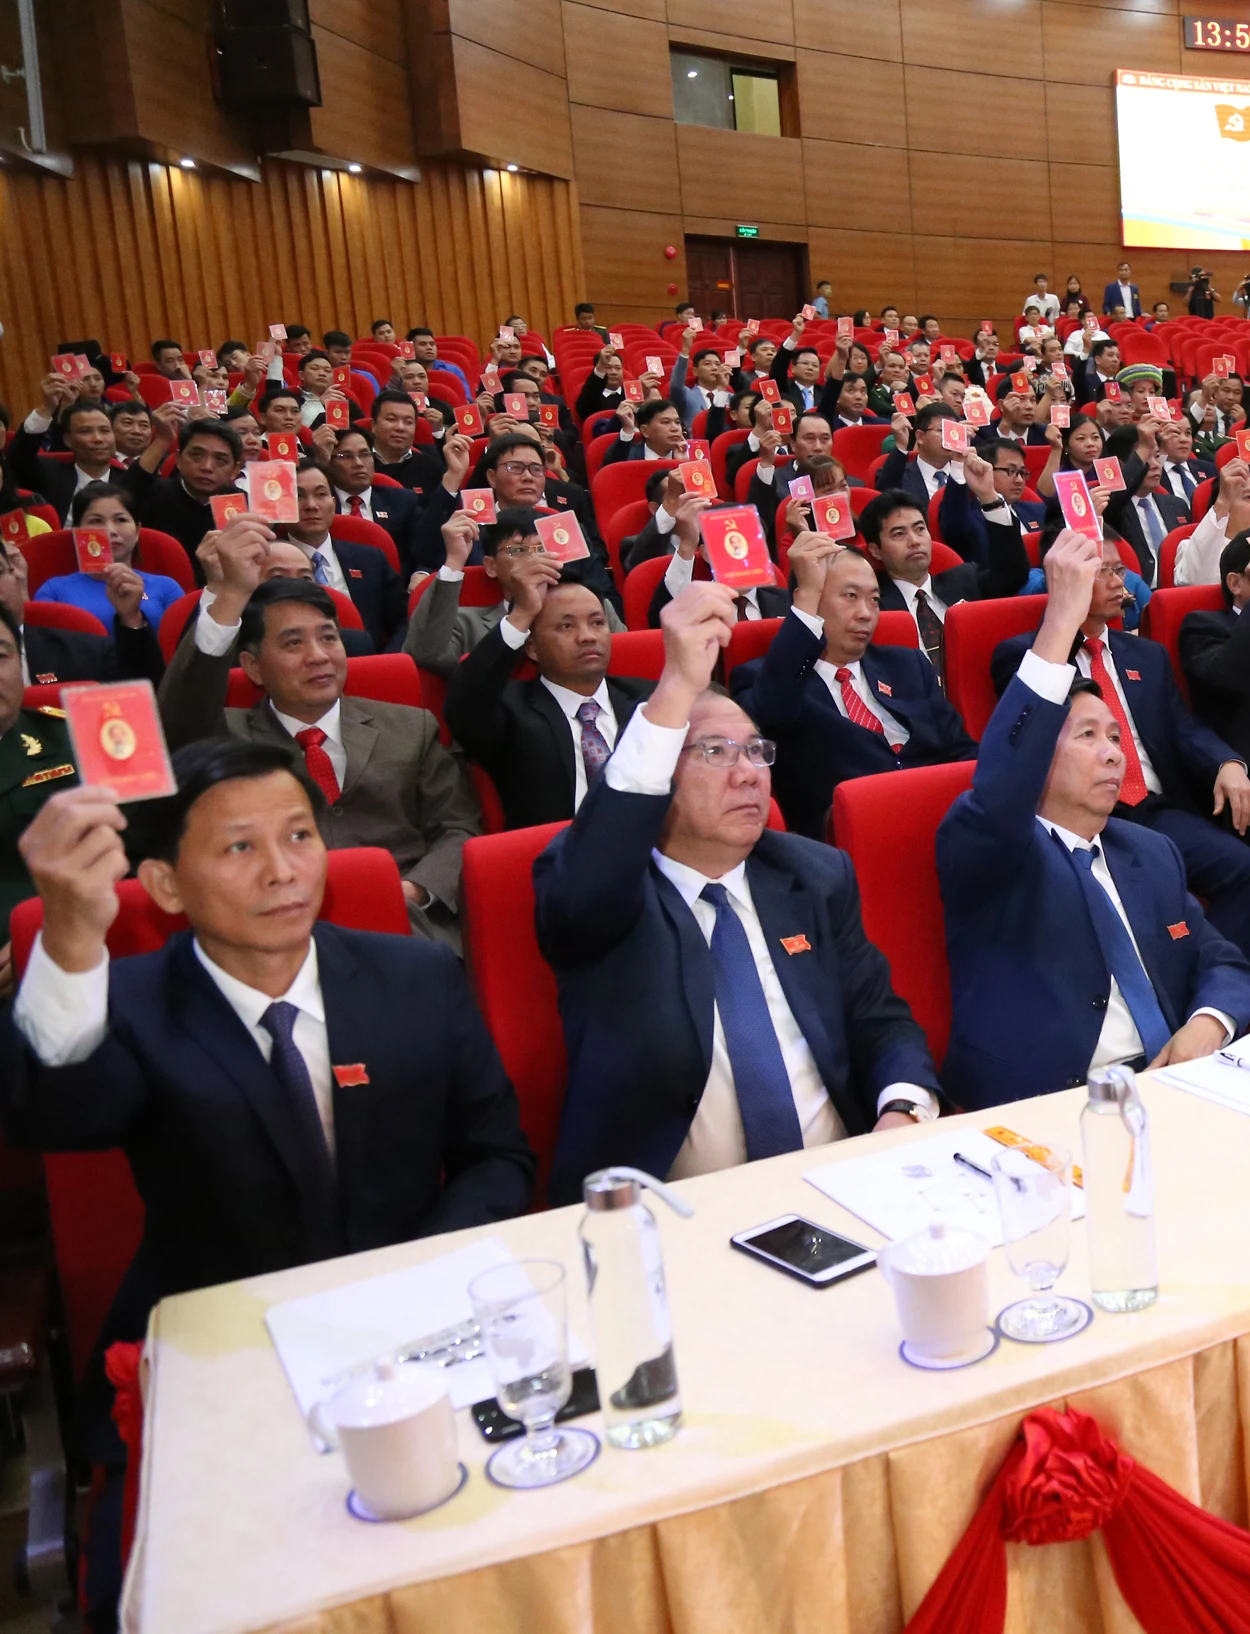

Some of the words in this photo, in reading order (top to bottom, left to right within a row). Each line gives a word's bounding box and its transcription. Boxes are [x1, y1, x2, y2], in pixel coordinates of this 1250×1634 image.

[1166, 77, 1193, 90] CỘNG
[1194, 79, 1212, 91] SẢN
[1213, 82, 1235, 94] VIỆT
